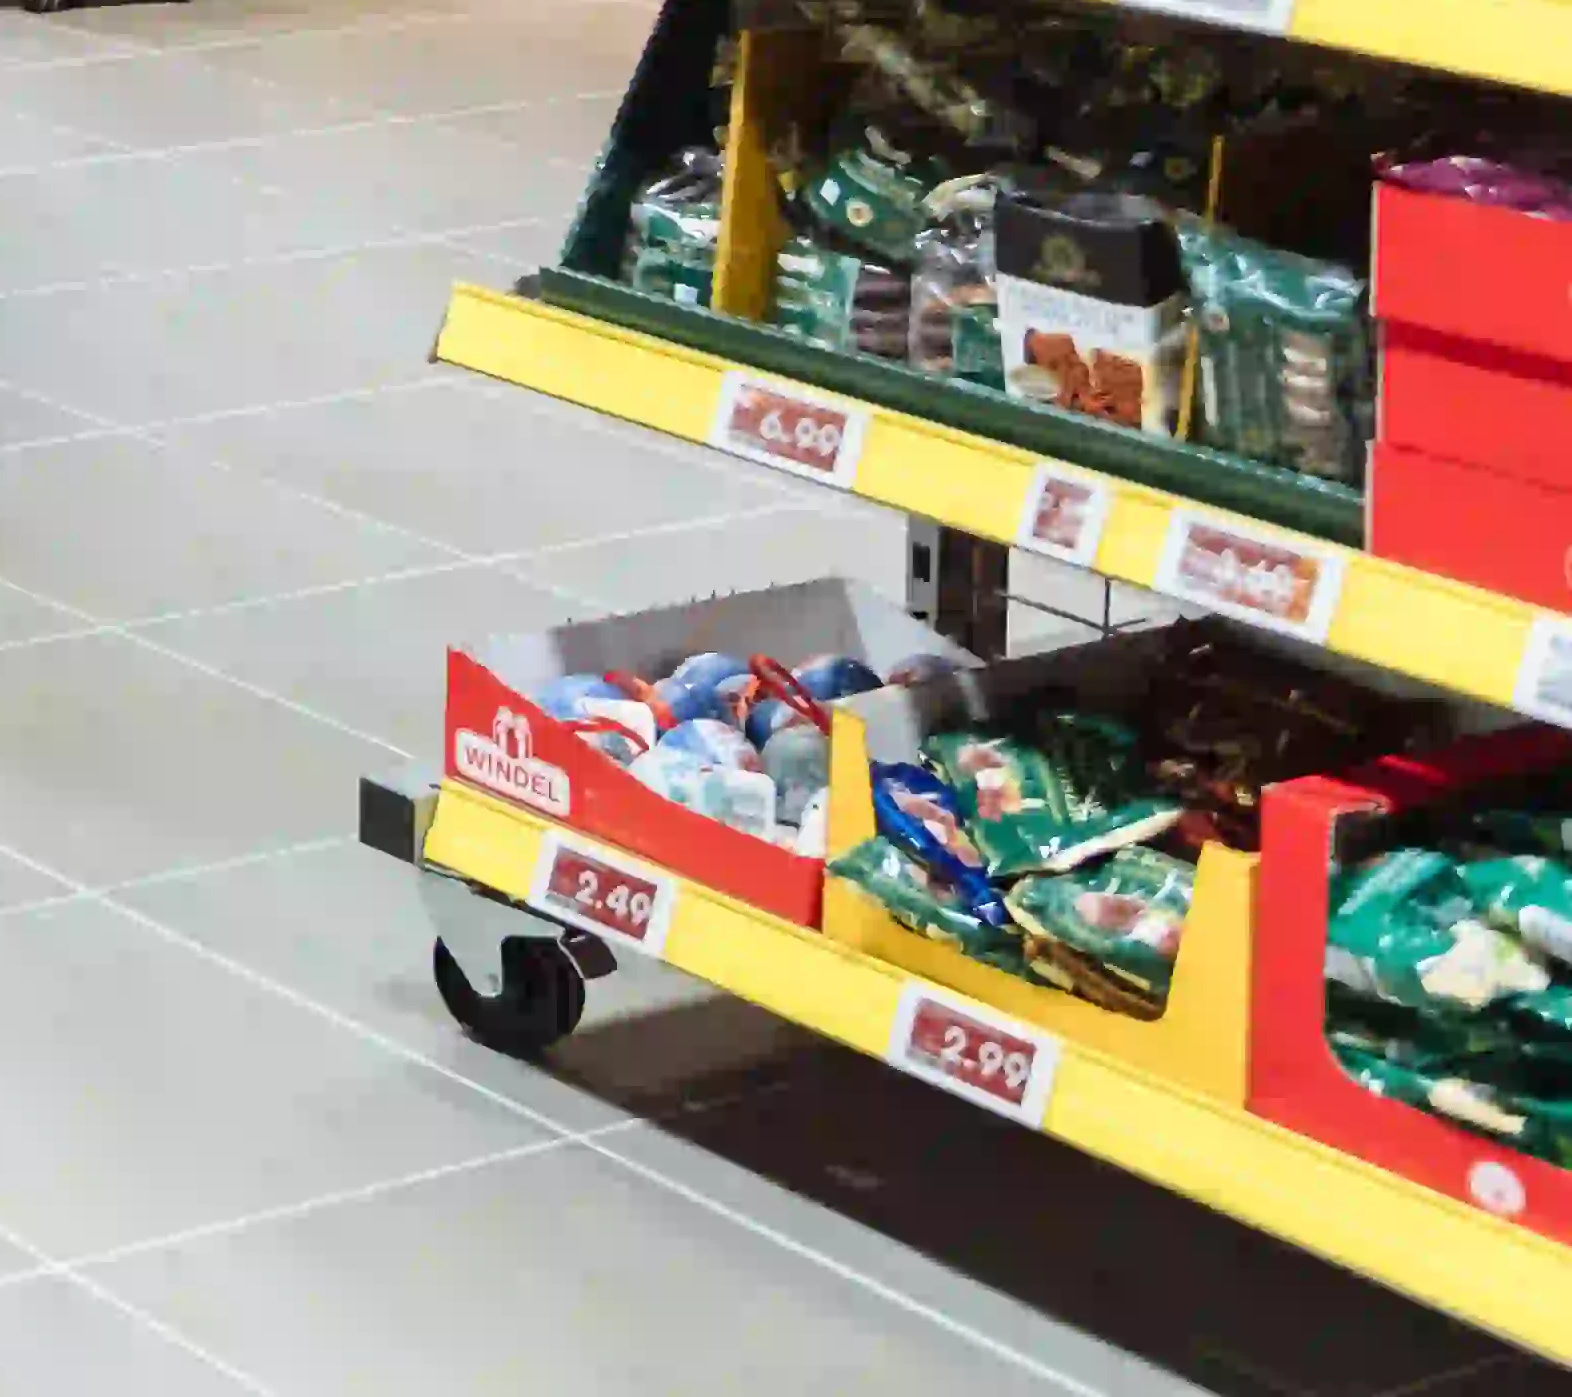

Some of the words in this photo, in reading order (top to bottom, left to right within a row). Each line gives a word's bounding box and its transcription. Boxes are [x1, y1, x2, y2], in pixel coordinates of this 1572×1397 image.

[760, 410, 841, 459] 6.99
[464, 746, 561, 804] WINDEL
[572, 869, 652, 922] 2.49
[939, 1025, 1030, 1090] 2.99
